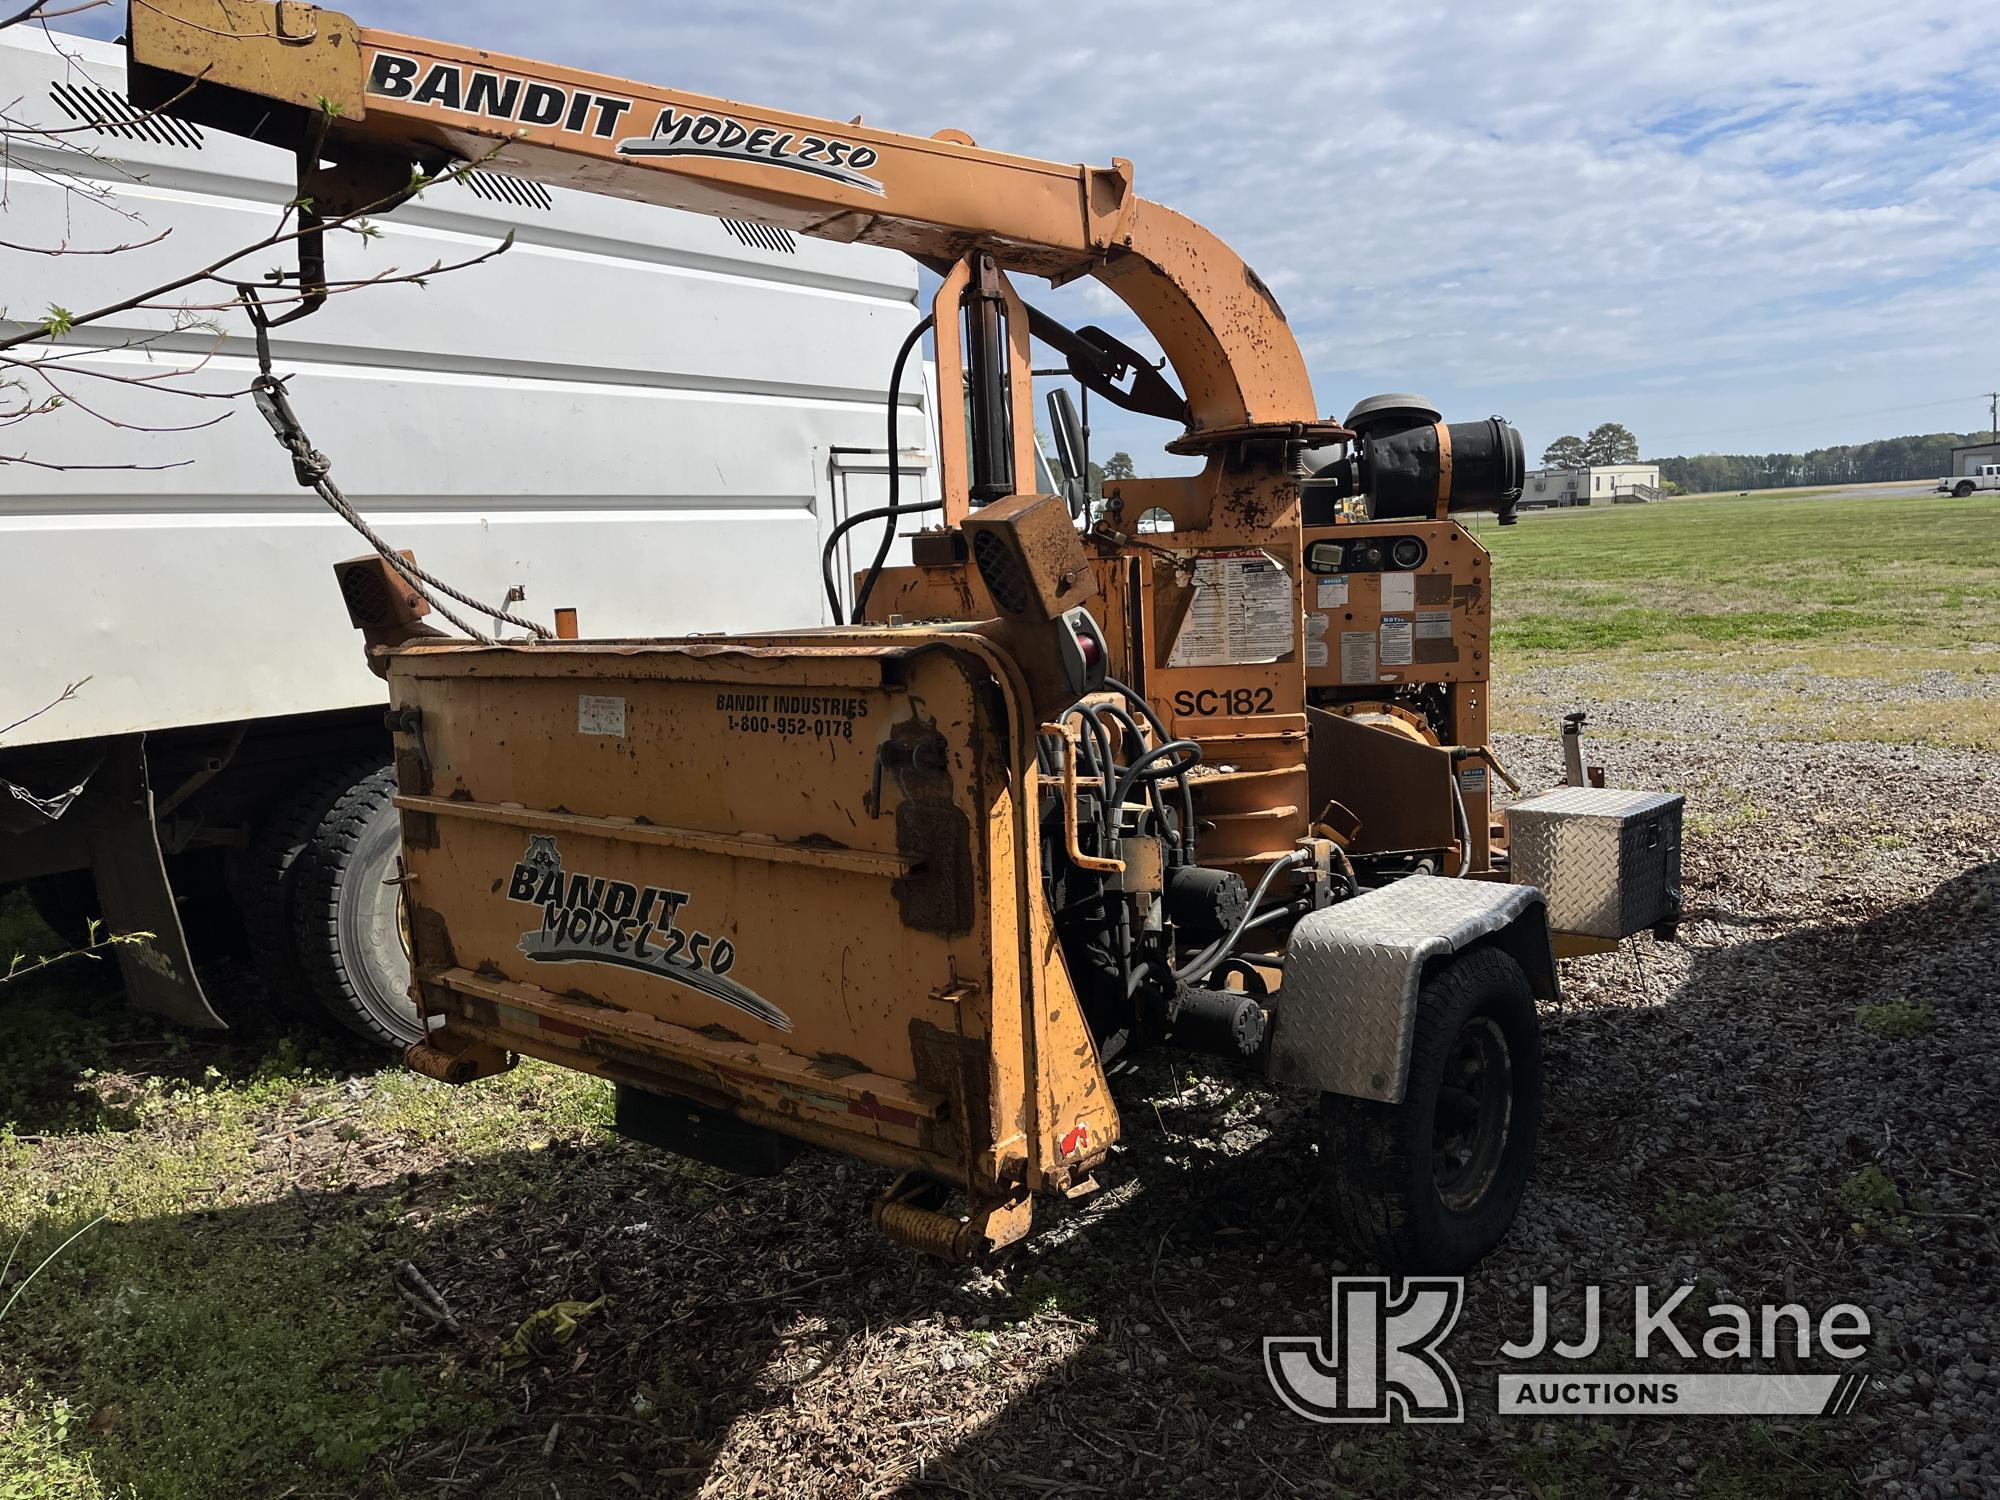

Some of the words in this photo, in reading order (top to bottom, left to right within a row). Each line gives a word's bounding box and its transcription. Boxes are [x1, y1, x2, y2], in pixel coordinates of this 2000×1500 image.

[366, 50, 631, 139] BANDIT
[651, 106, 796, 160] MODEL
[794, 135, 879, 170] 250
[715, 693, 769, 714] BANDIT
[773, 695, 869, 719] INDUSTRIES
[728, 714, 853, 738] 1-800-952-0178
[1174, 686, 1275, 717] SC182
[507, 862, 690, 933] BANDIT
[541, 901, 655, 959] MODEL
[662, 927, 736, 976] 250
